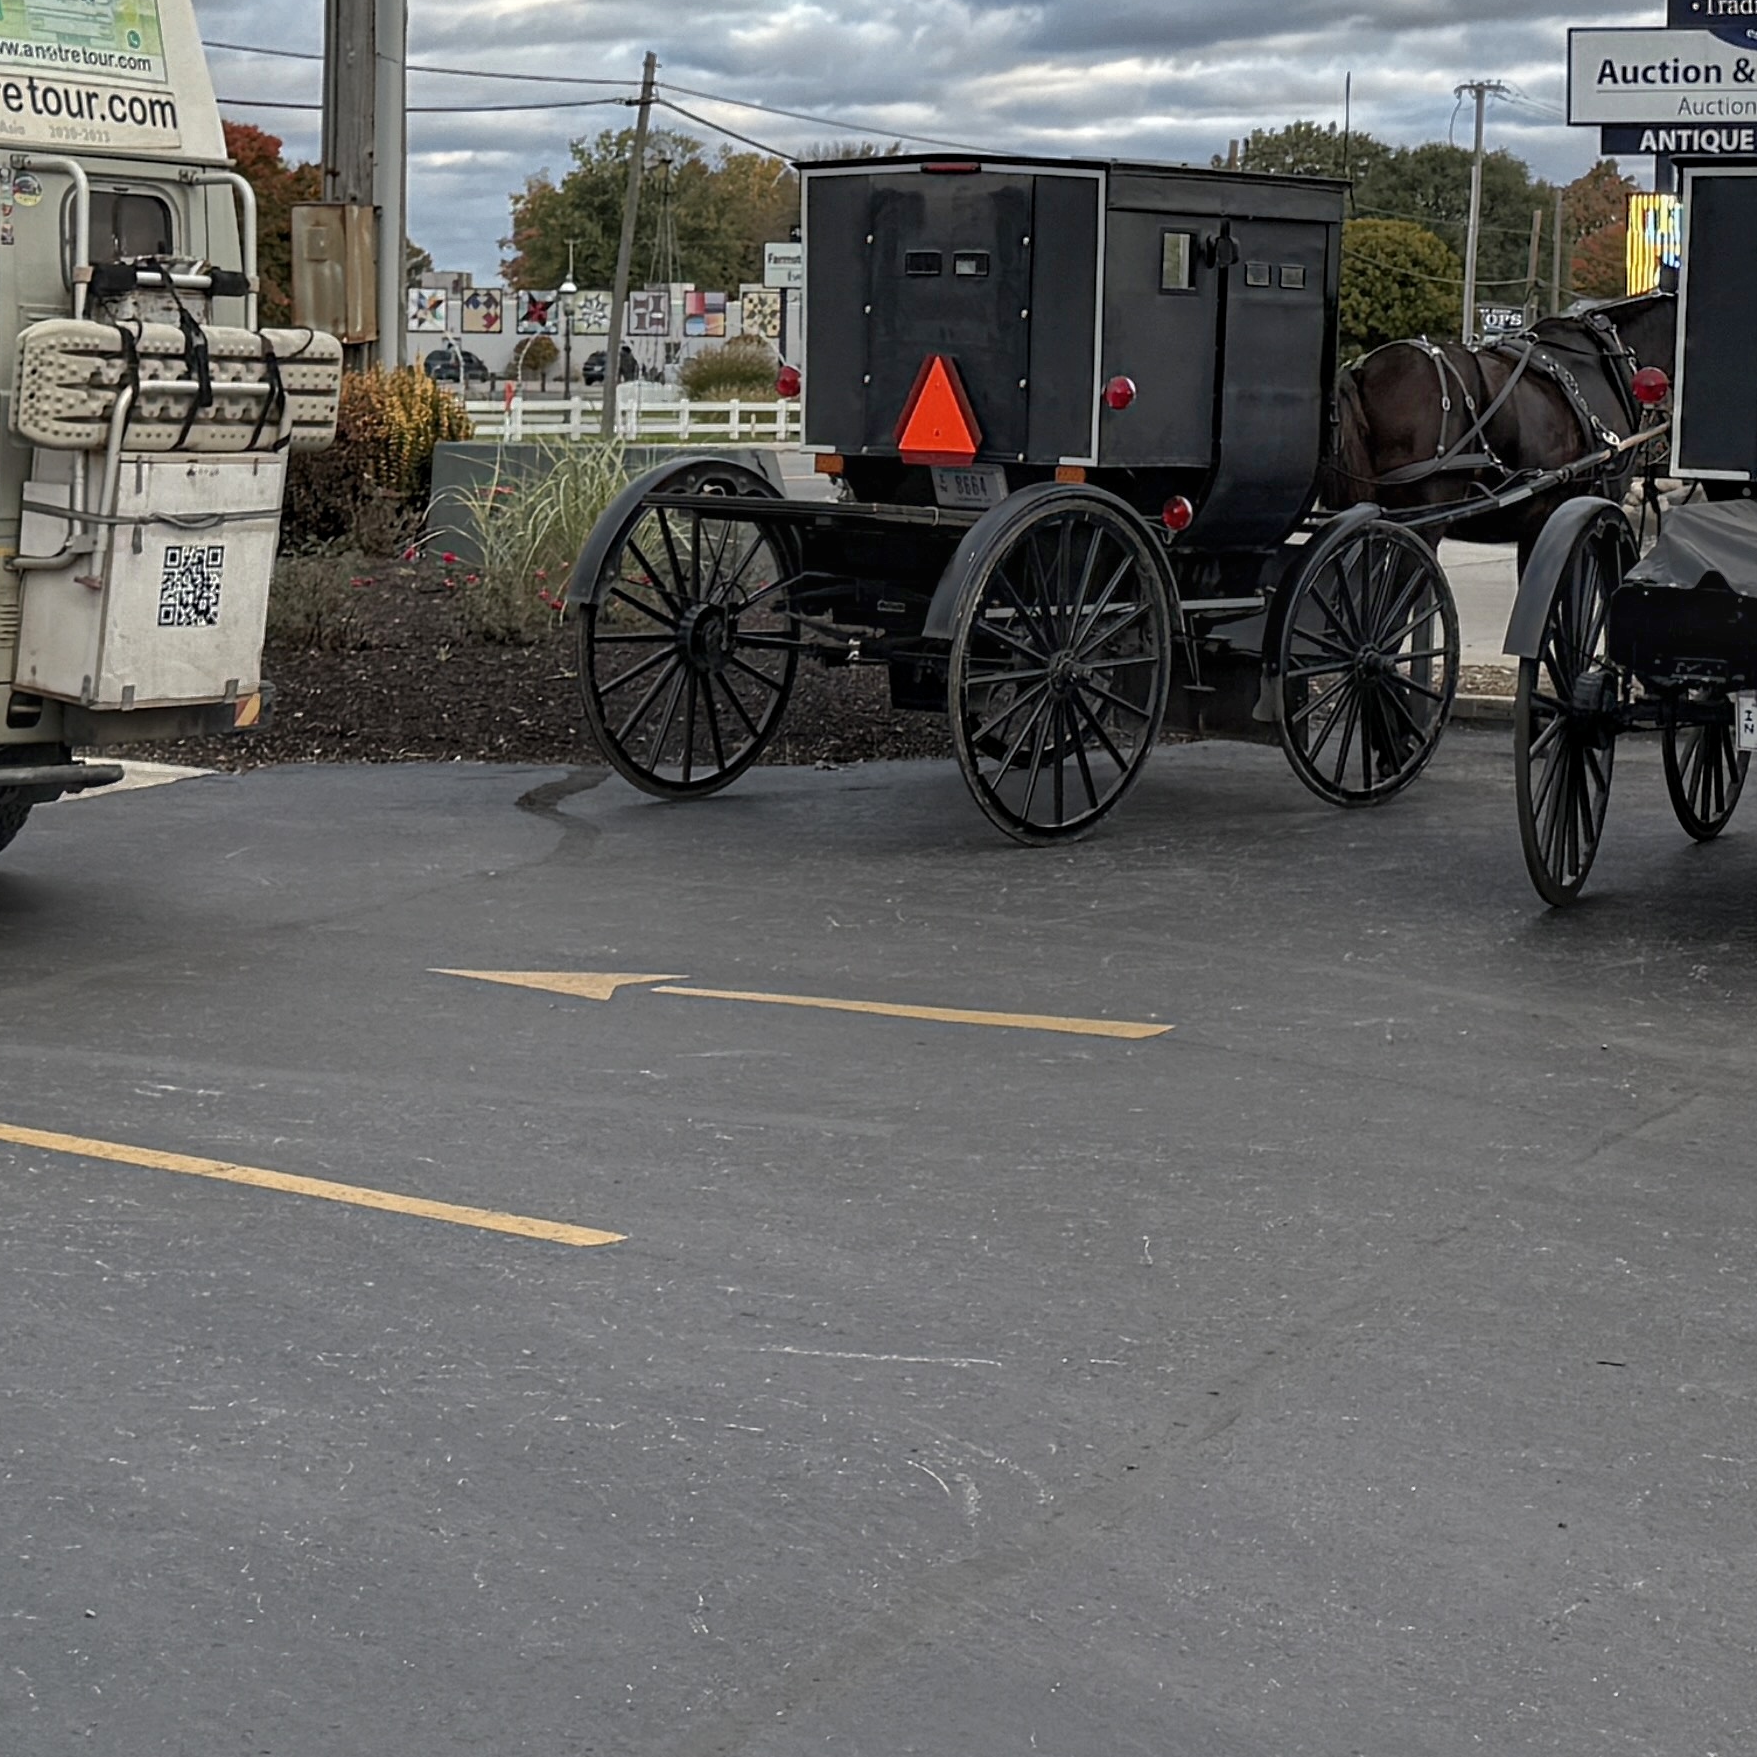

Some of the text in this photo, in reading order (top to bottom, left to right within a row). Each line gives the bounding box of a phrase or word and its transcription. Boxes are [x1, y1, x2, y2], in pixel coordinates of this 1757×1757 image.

[1596, 59, 1722, 85] Auction
[1733, 58, 1755, 83] &
[1678, 96, 1757, 116] Auction
[0, 120, 25, 136] Asia
[1639, 128, 1755, 154] ANTIQUE
